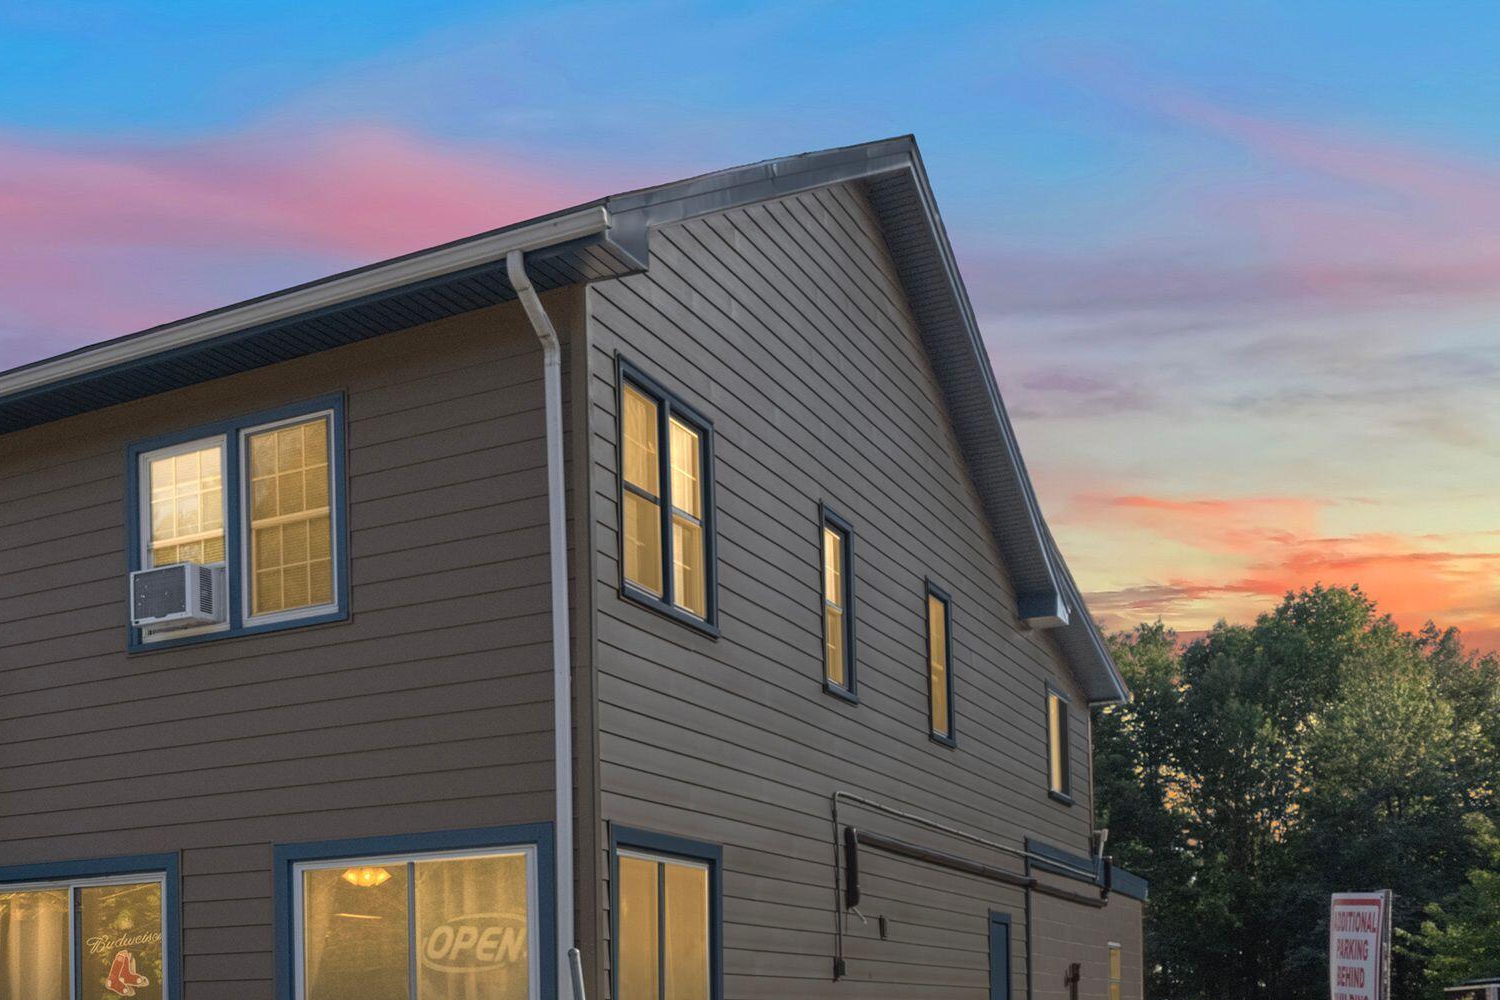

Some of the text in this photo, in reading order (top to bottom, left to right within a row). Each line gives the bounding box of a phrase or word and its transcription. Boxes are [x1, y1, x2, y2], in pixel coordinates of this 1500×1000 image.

[426, 925, 527, 962] OPEN
[1336, 938, 1369, 961] PARKING
[1337, 965, 1365, 989] BEHIND
